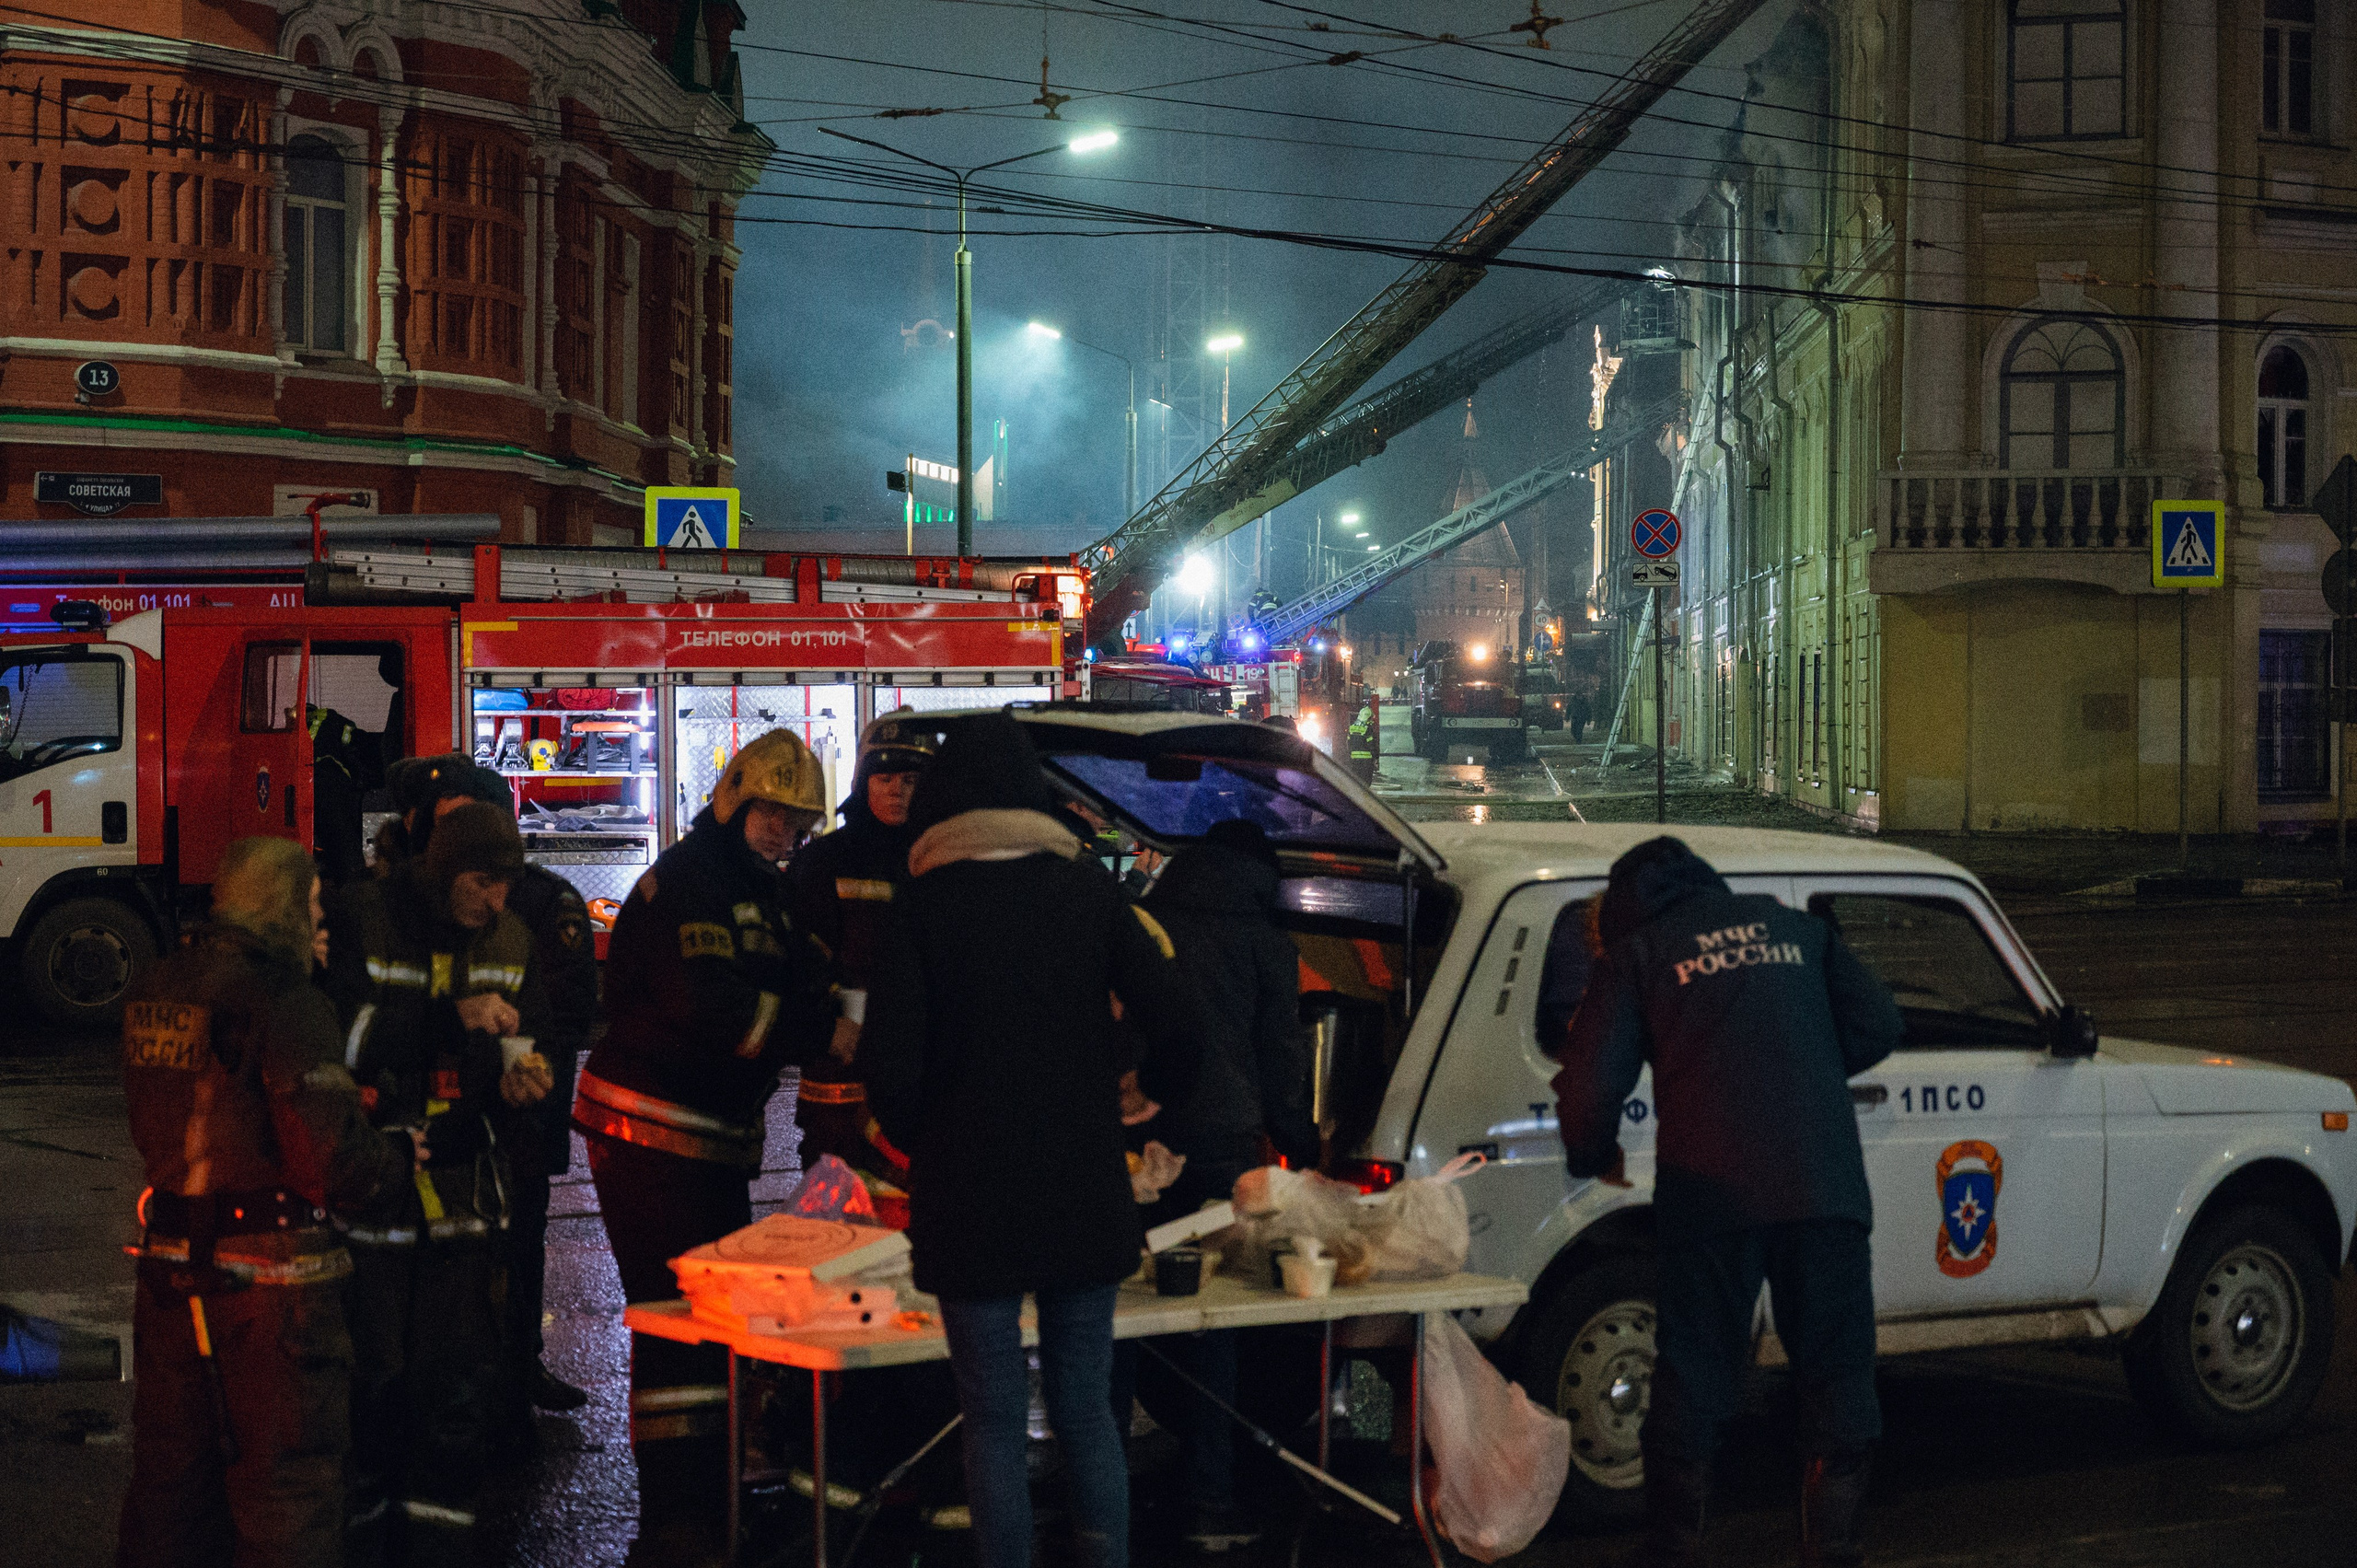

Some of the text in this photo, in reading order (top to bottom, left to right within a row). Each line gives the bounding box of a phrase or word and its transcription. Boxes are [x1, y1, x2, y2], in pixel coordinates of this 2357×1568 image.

[89, 369, 109, 386] 13
[69, 484, 131, 496] СОВЕТСКАЯ
[89, 505, 110, 513] УЛИЦА
[679, 631, 781, 646] ТЕЛЕФОН
[32, 789, 52, 833] 1
[97, 867, 109, 876] 60
[1695, 923, 1770, 951] МЧС
[1675, 942, 1805, 986] РОССИИ
